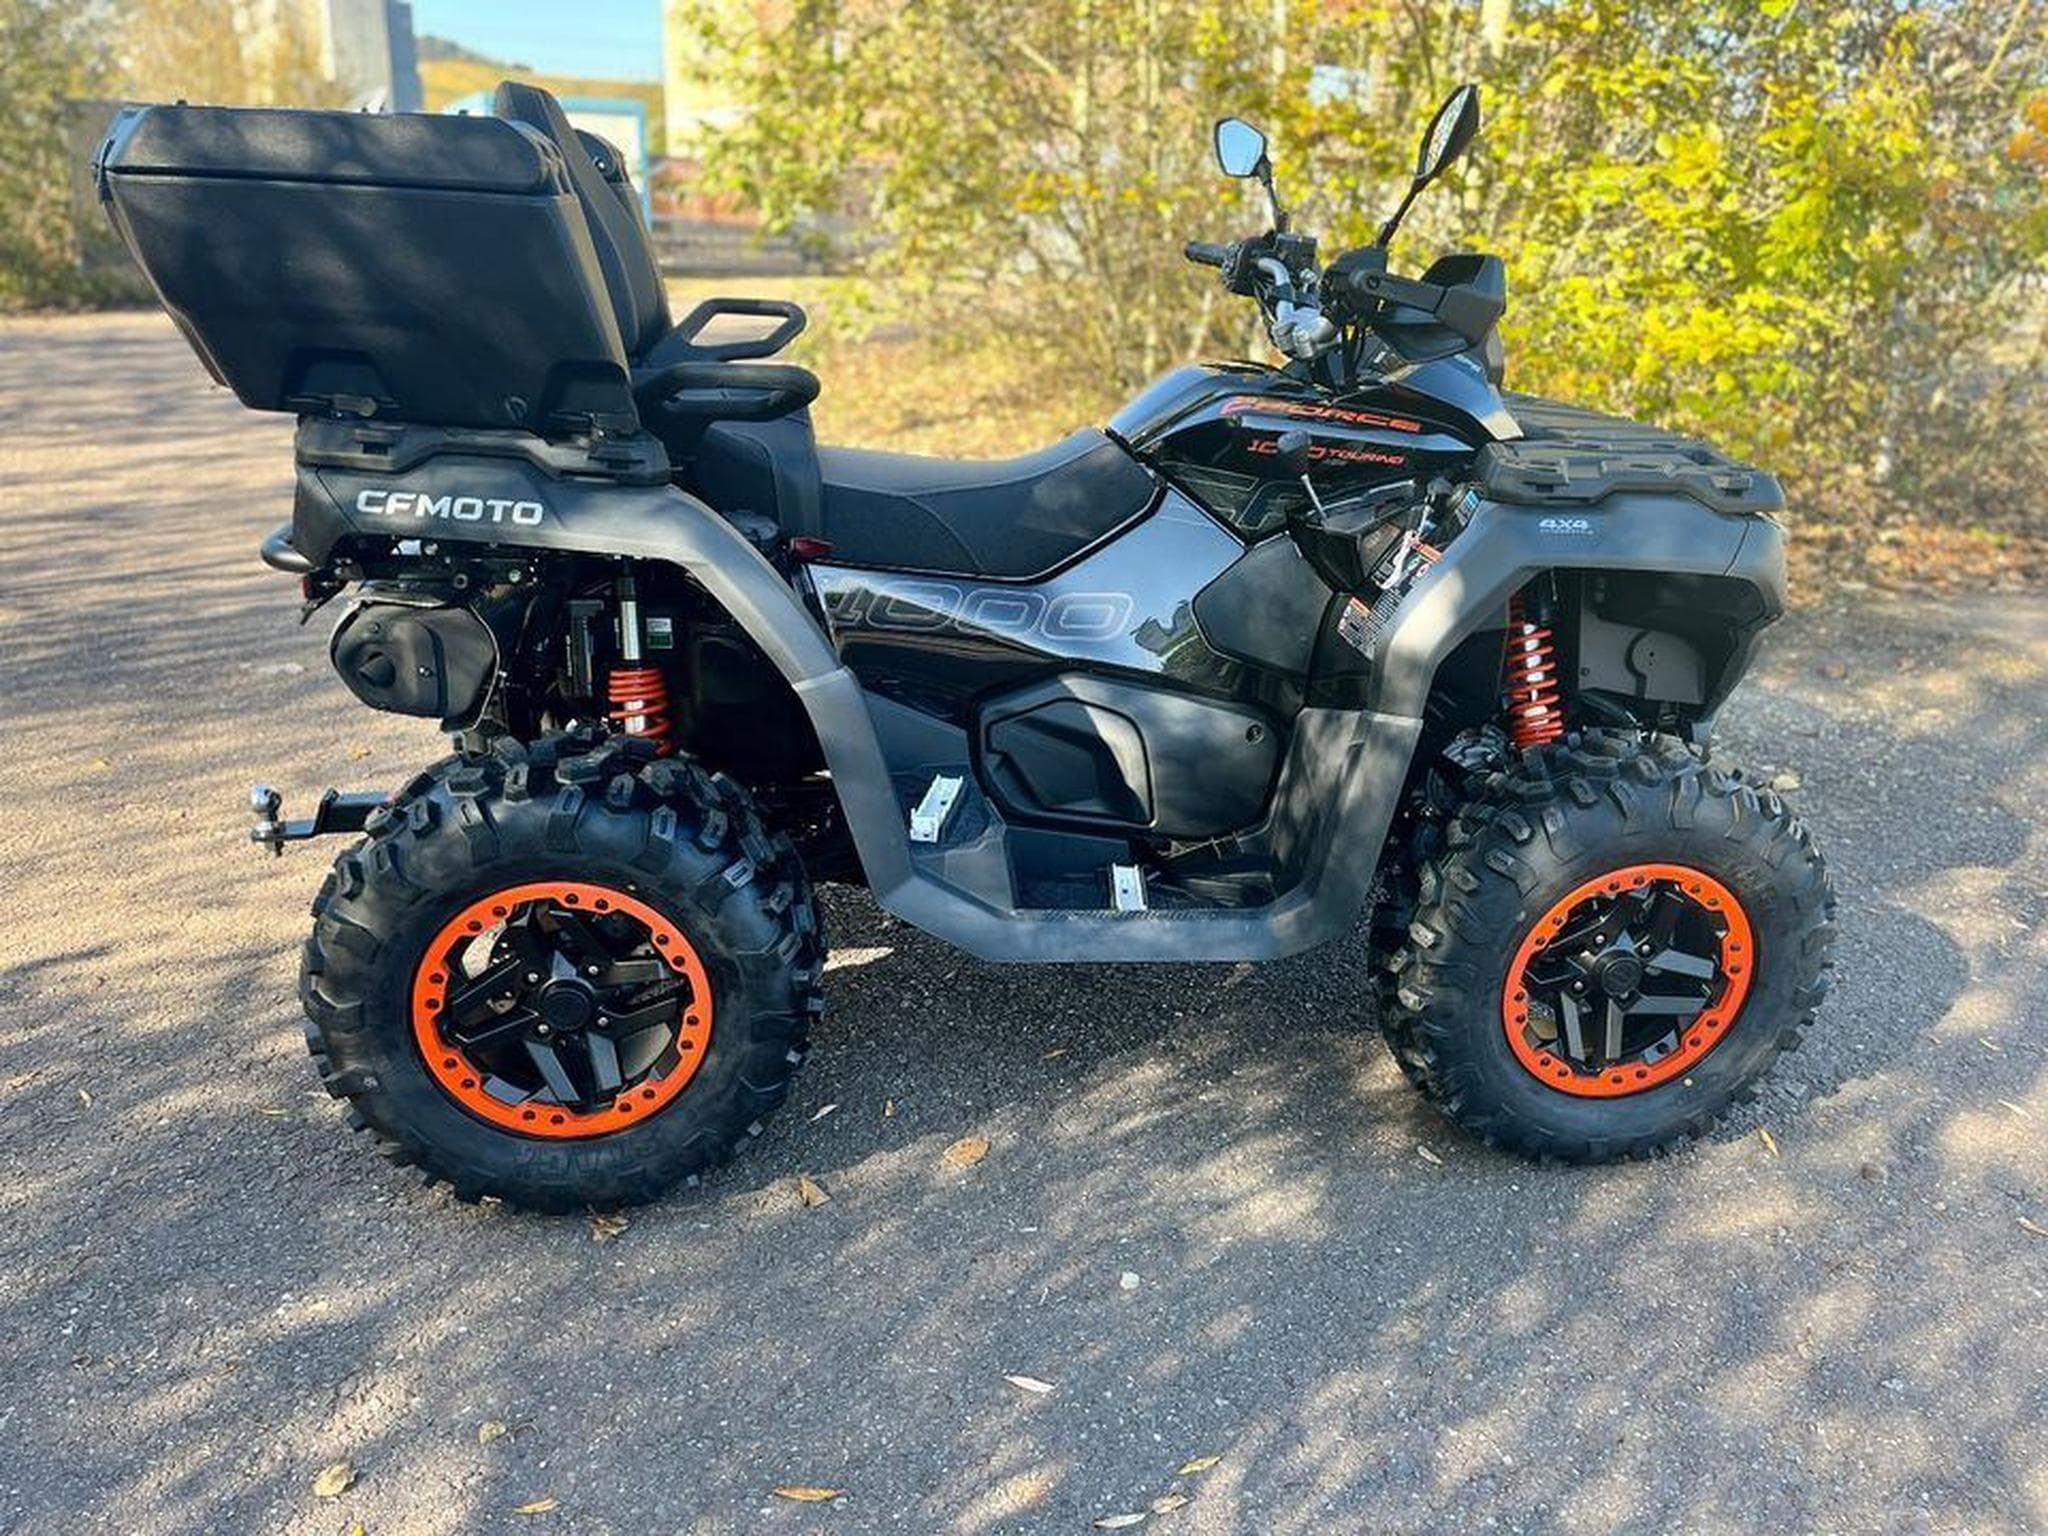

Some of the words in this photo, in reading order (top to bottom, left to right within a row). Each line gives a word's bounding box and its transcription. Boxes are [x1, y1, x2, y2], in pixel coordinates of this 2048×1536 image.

[1329, 448, 1405, 464] TOURING
[356, 489, 544, 526] CFMOTO
[829, 580, 1134, 641] 1000
